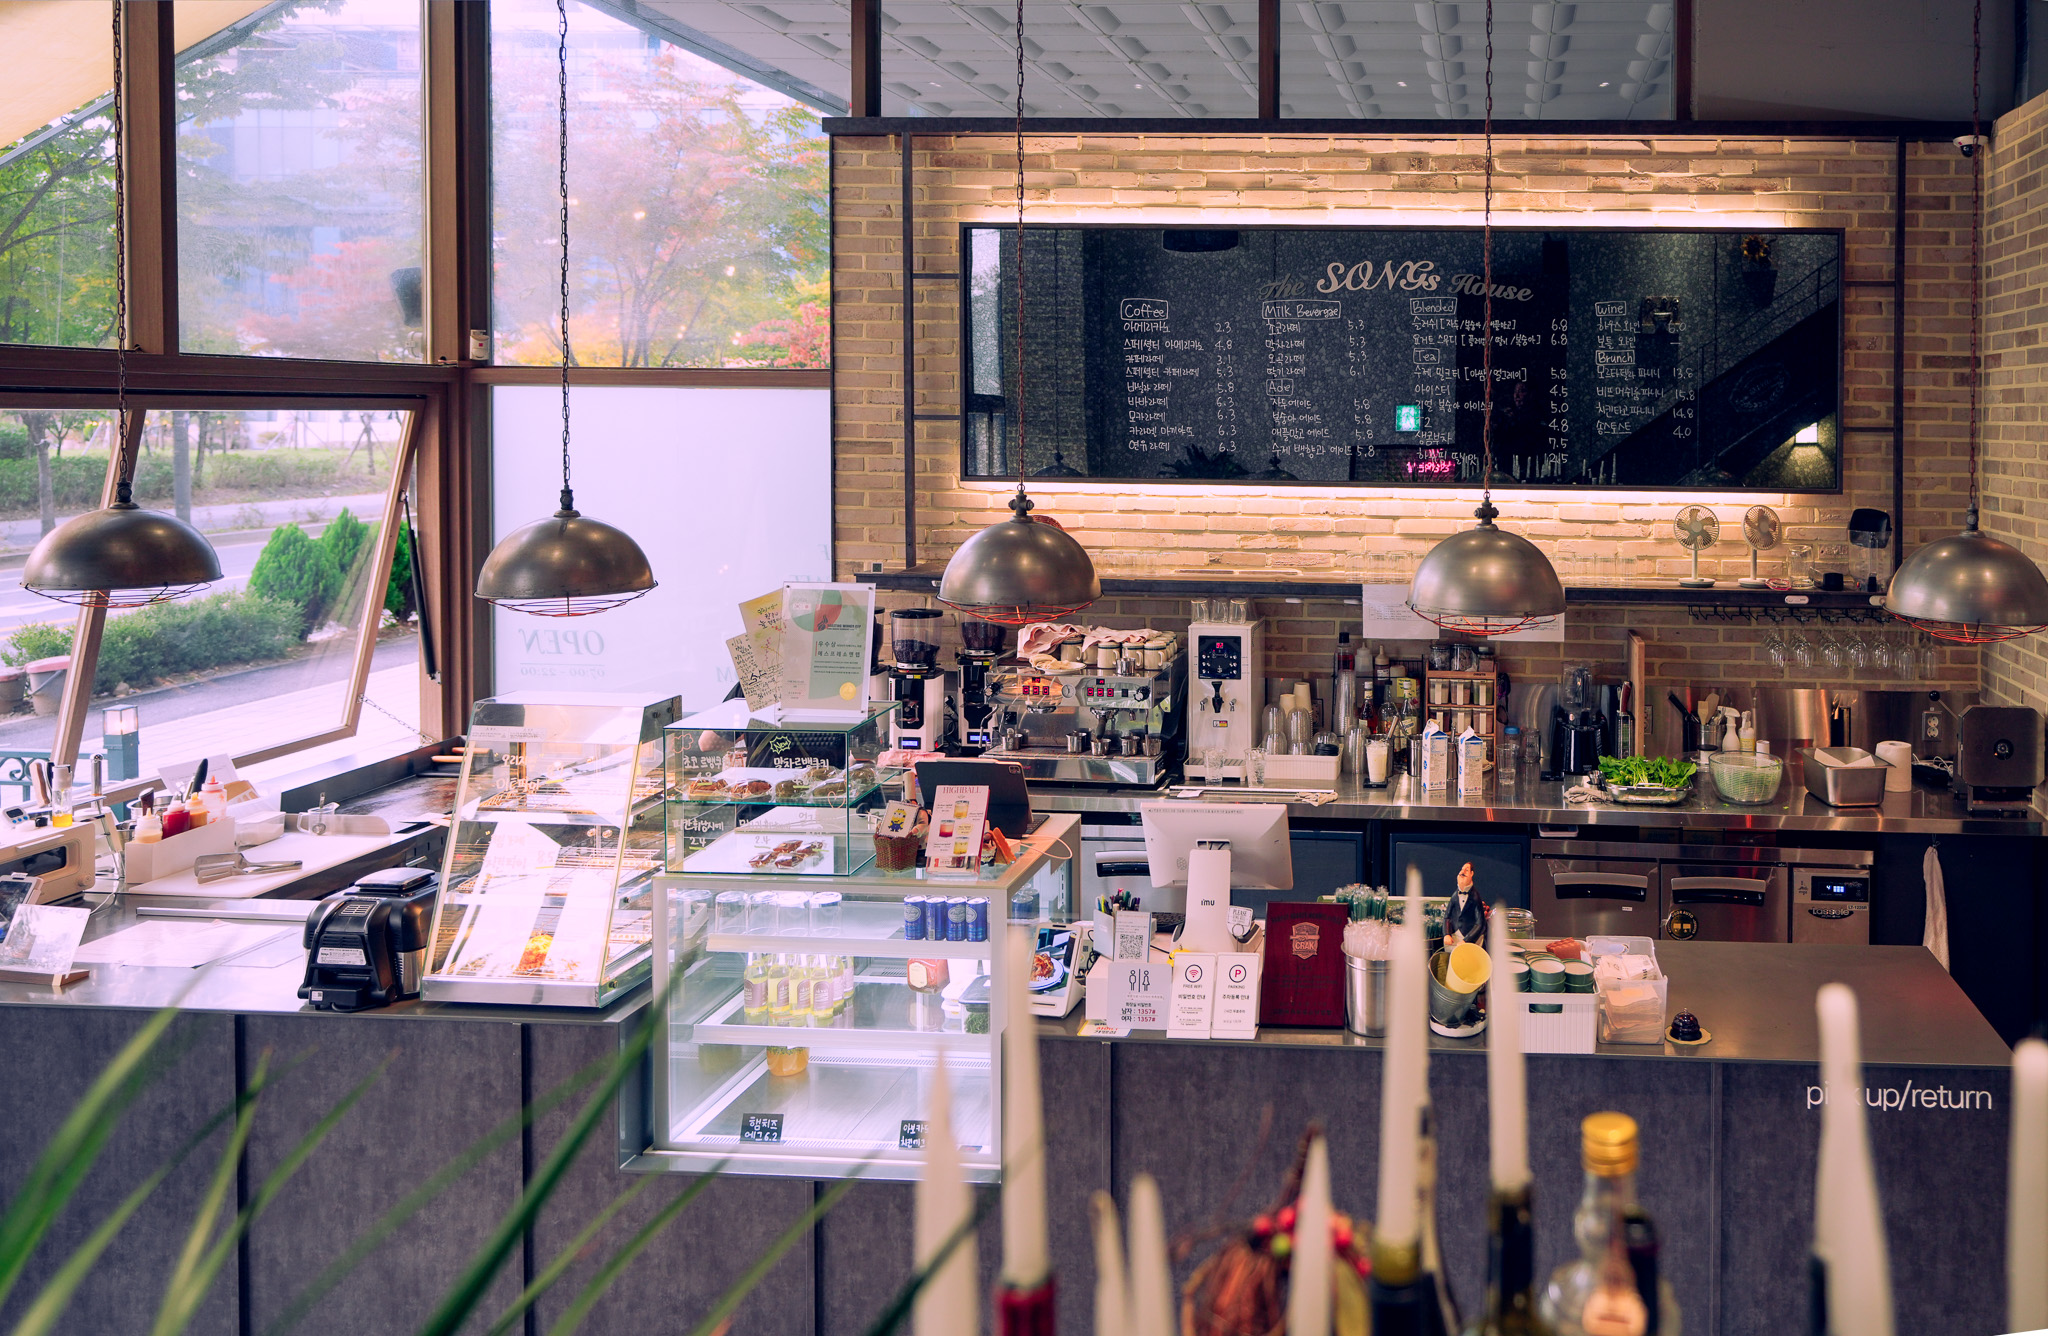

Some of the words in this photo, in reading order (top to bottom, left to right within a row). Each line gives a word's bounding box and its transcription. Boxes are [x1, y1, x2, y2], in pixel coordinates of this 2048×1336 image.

[1258, 274, 1306, 300] The
[1448, 273, 1533, 301] House
[1125, 304, 1165, 318] Coffee
[1265, 305, 1291, 317] Milk
[1413, 301, 1454, 313] Blended
[1123, 321, 1170, 333] 아메리카노
[1215, 322, 1231, 333] 2.3
[1348, 320, 1364, 330] 5.3
[1551, 319, 1568, 331] 6.8
[1597, 318, 1622, 333] 하우스
[1623, 321, 1641, 333] 와인
[1668, 320, 1686, 333] 6.0
[1165, 340, 1204, 351] 아메리카노
[1215, 340, 1232, 350] 4.8
[1265, 338, 1305, 351] 말차라떼
[1349, 335, 1365, 348] 5.3
[1551, 334, 1568, 346] 6.8
[1618, 337, 1636, 348] 와인
[1349, 351, 1366, 362] 5.3
[1415, 350, 1436, 361] Tea
[1598, 352, 1632, 363] Brunch
[1217, 366, 1234, 378] 5.3
[1267, 366, 1305, 377] 딸기라떼
[1349, 365, 1365, 376] 6.1
[1551, 368, 1567, 379] 5.8
[1217, 382, 1234, 393] 5.8
[1269, 380, 1290, 392] Ade
[1549, 385, 1568, 397] 4.5
[1675, 389, 1695, 401] 15.8
[1216, 397, 1234, 408] 6.3
[1354, 399, 1370, 410] 5.8
[1438, 399, 1460, 412] 복숭아
[1550, 401, 1568, 413] 5.0
[1129, 410, 1165, 422] 모카라떼
[1217, 409, 1235, 421] 6.3
[1273, 412, 1296, 424] 복숭아
[1299, 414, 1321, 423] 에이드
[1355, 414, 1372, 424] 5.8
[1673, 408, 1693, 418] 14.8
[1218, 425, 1236, 436] 6.3
[1549, 419, 1568, 432] 4.8
[1272, 428, 1304, 441] 애플망고
[1307, 428, 1330, 438] 에이드
[1356, 429, 1373, 440] 5.8
[1673, 426, 1691, 438] 4.0
[1219, 441, 1236, 452] 6.3
[1549, 438, 1568, 449] 7.5
[1272, 443, 1290, 457] 수제
[1294, 443, 1326, 458] 백향과
[1330, 446, 1352, 455] 에이드
[1357, 445, 1375, 457] 5.8
[774, 741, 788, 751] New
[1807, 1080, 1861, 1109] pik
[1866, 1079, 1992, 1111] up/return
[748, 1116, 778, 1131] 햄치즈
[744, 1131, 763, 1141] 에그
[764, 1132, 778, 1141] 6.2
